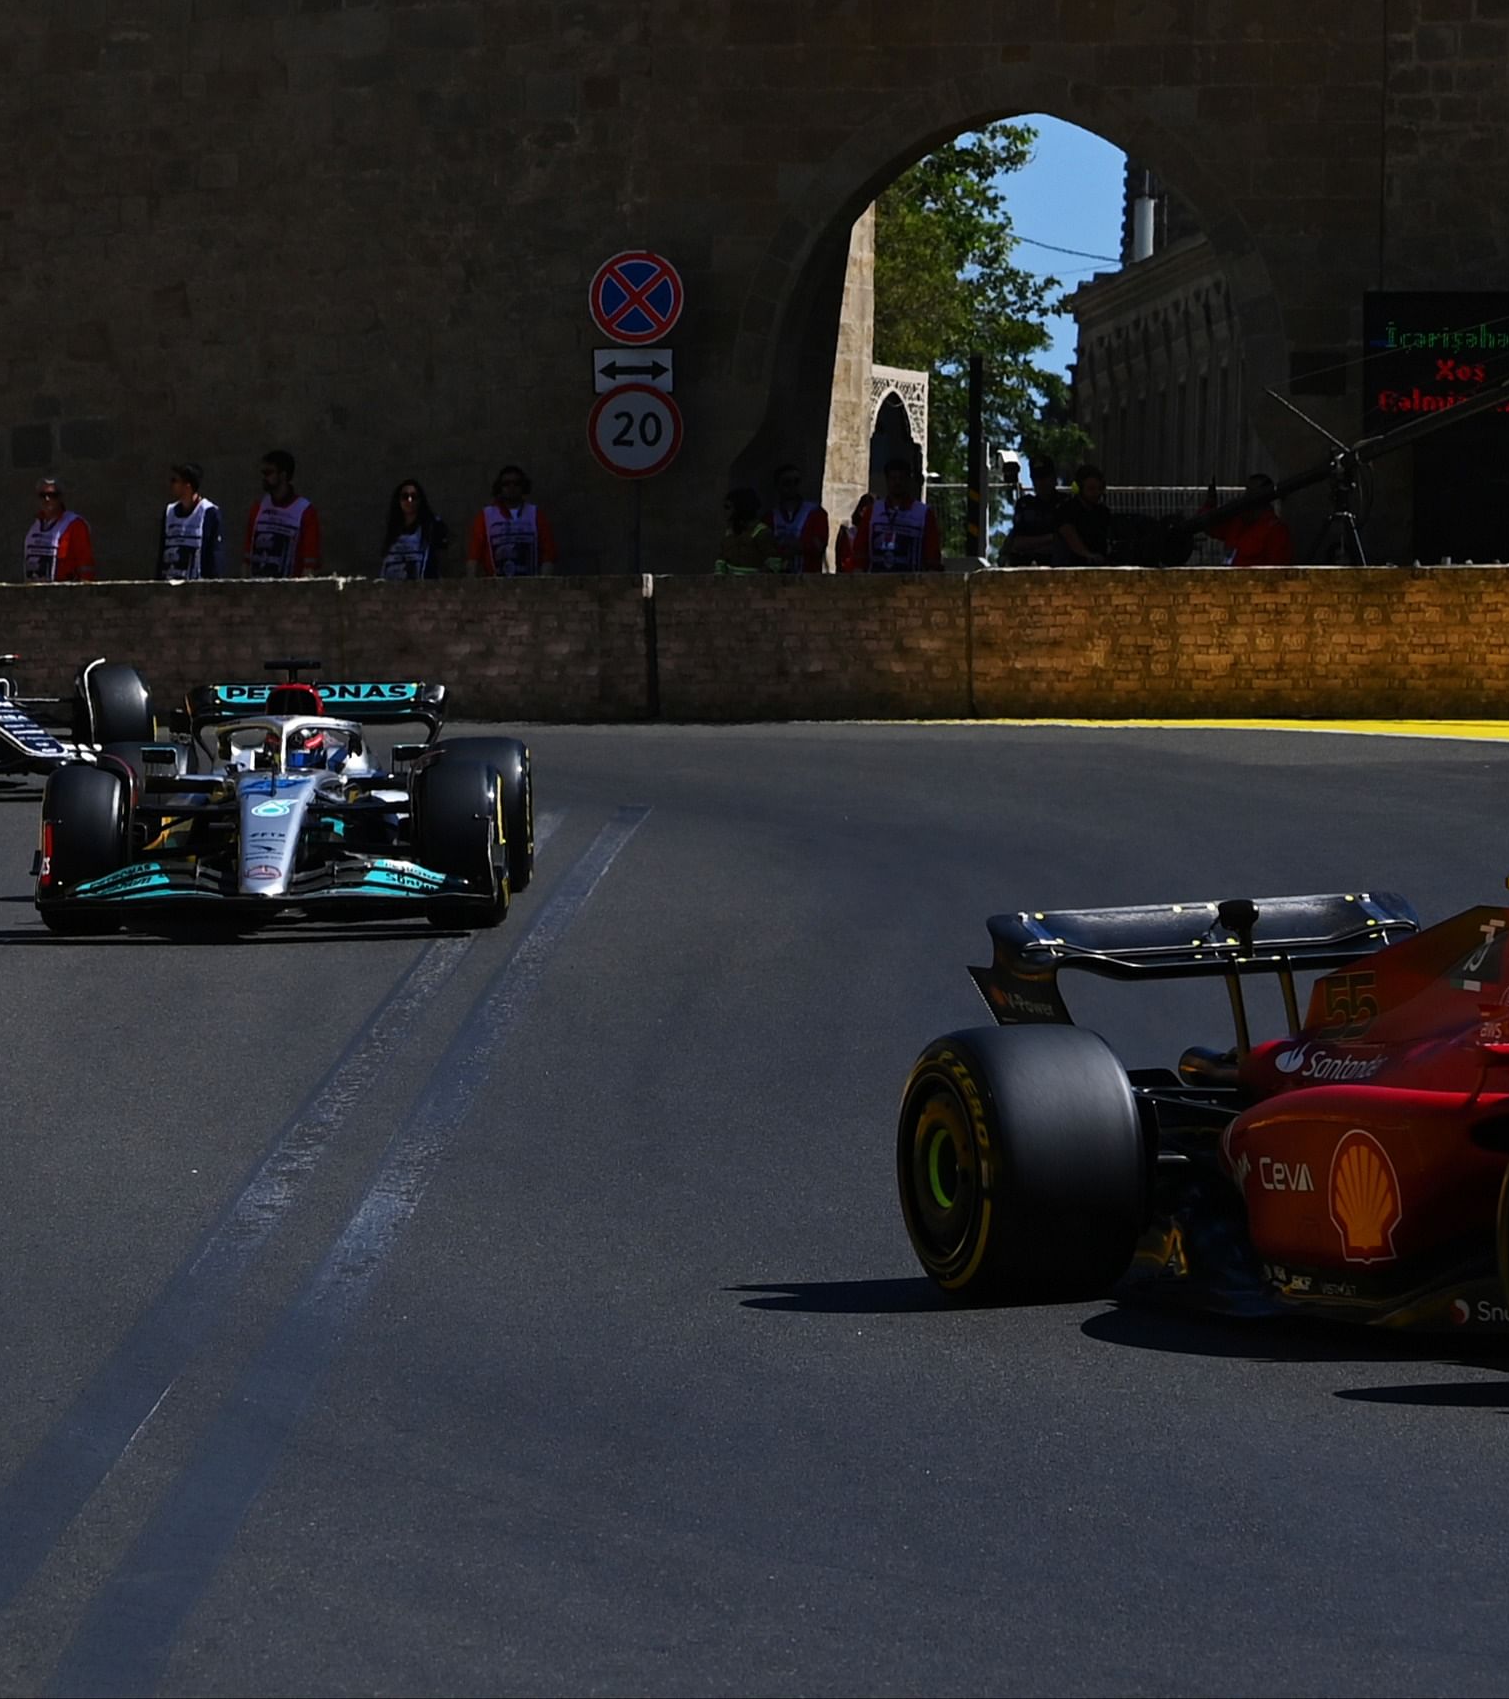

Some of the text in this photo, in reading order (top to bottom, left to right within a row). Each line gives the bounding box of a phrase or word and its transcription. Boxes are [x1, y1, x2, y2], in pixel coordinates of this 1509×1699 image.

[612, 411, 663, 448] 20
[227, 685, 407, 700] PEONAS
[1315, 969, 1381, 1042] 55
